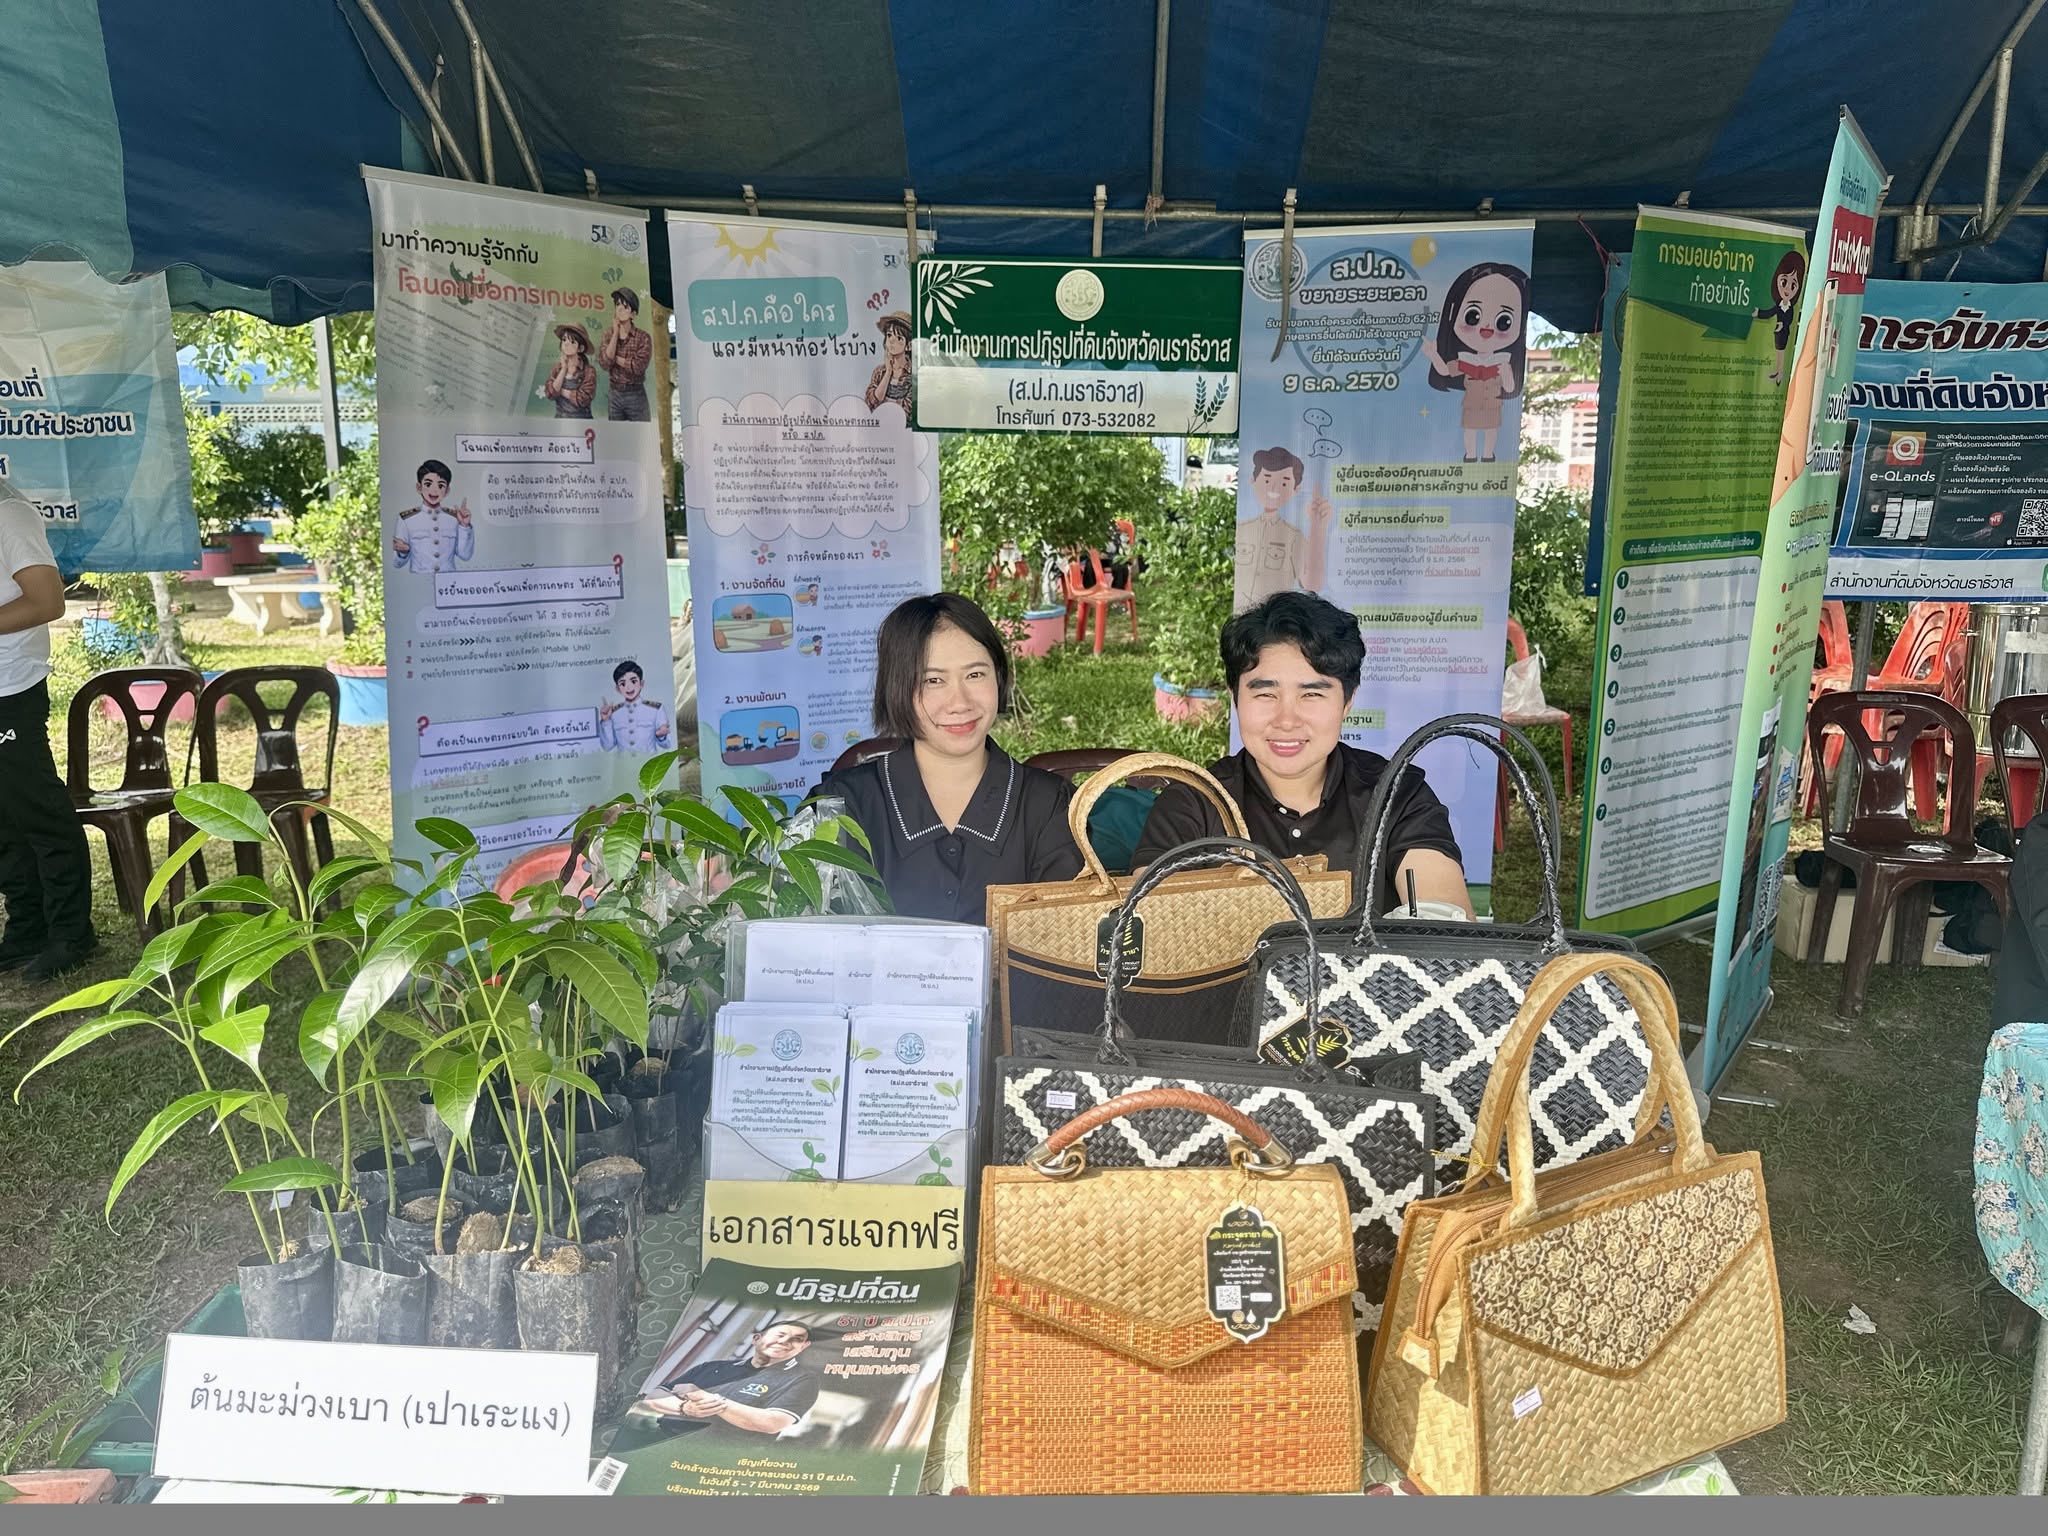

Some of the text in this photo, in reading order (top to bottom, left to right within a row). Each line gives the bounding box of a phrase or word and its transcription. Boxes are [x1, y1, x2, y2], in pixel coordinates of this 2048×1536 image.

[381, 230, 539, 265] มาทำความรู้จักกับ
[1658, 241, 1756, 274] การมอบอำนาจ
[1330, 250, 1405, 281] ส.ป.ก.
[399, 267, 606, 312] โฉนดเพื่อการเกษตร
[1299, 284, 1428, 304] ขยายระยะเวลา
[1689, 276, 1750, 307] ทำอย่างไร
[702, 292, 836, 327] ส.ป.ก.คือใคร
[712, 328, 876, 358] และมีหน้าที่อะไรบ้าง
[1284, 327, 1422, 341] กษตรกรอื่นโดยไม่ได้รับอนุญาต
[929, 323, 1232, 368] สำนักงานการปฏิรูปที่ดินจังหวัดนราธิวาส
[1312, 345, 1401, 364] ยื่นได้จนถึงวันที่
[1303, 376, 1341, 392] ธ.ค.
[1346, 372, 1399, 392] 2570
[1008, 377, 1144, 408] (ส.ป.ก.นราธิวาส)
[722, 411, 880, 427] สำนักงานการปฏิรูปที่ดินเพื่อเกษตรกรรม
[996, 404, 1156, 428] โทรศัพท์ 073-532082
[462, 440, 581, 454] โฉนดเพื่อการเกษตร คืออะไร
[1336, 464, 1463, 483] ผู้ยื่นจะต้องมีคุณสมบัติ
[1869, 470, 1937, 483] e-QLands
[1335, 476, 1509, 494] และเตรียมเอกสารหลักฐาน ดังนี้
[1344, 511, 1445, 528] ผู้ที่สามารถยื่นคำขอ
[731, 574, 786, 590] งานจัดที่ดิน
[1829, 570, 2015, 590] สำนักงานที่ดินจังหวัดนราธิวาส
[551, 611, 557, 619] 3
[736, 690, 787, 704] งานพัฒนา
[744, 777, 806, 794] านเพิ่มรายได้
[710, 1207, 960, 1251] เอกสารแจกฟรี
[775, 1276, 921, 1304] ปฏิรูปที่ดิน
[190, 1371, 571, 1438] ต้นมะม่วงเบา (เปาเระแง)
[670, 1460, 857, 1482] วันคล้ายวันสถาปนาครบรอบ 51 ปี ส.ป.ก.
[737, 1457, 798, 1469] เชิญเที่ยวงาน
[699, 1476, 732, 1487] ในวันที่
[757, 1480, 792, 1490] มีนาคม
[793, 1483, 820, 1492] 2569
